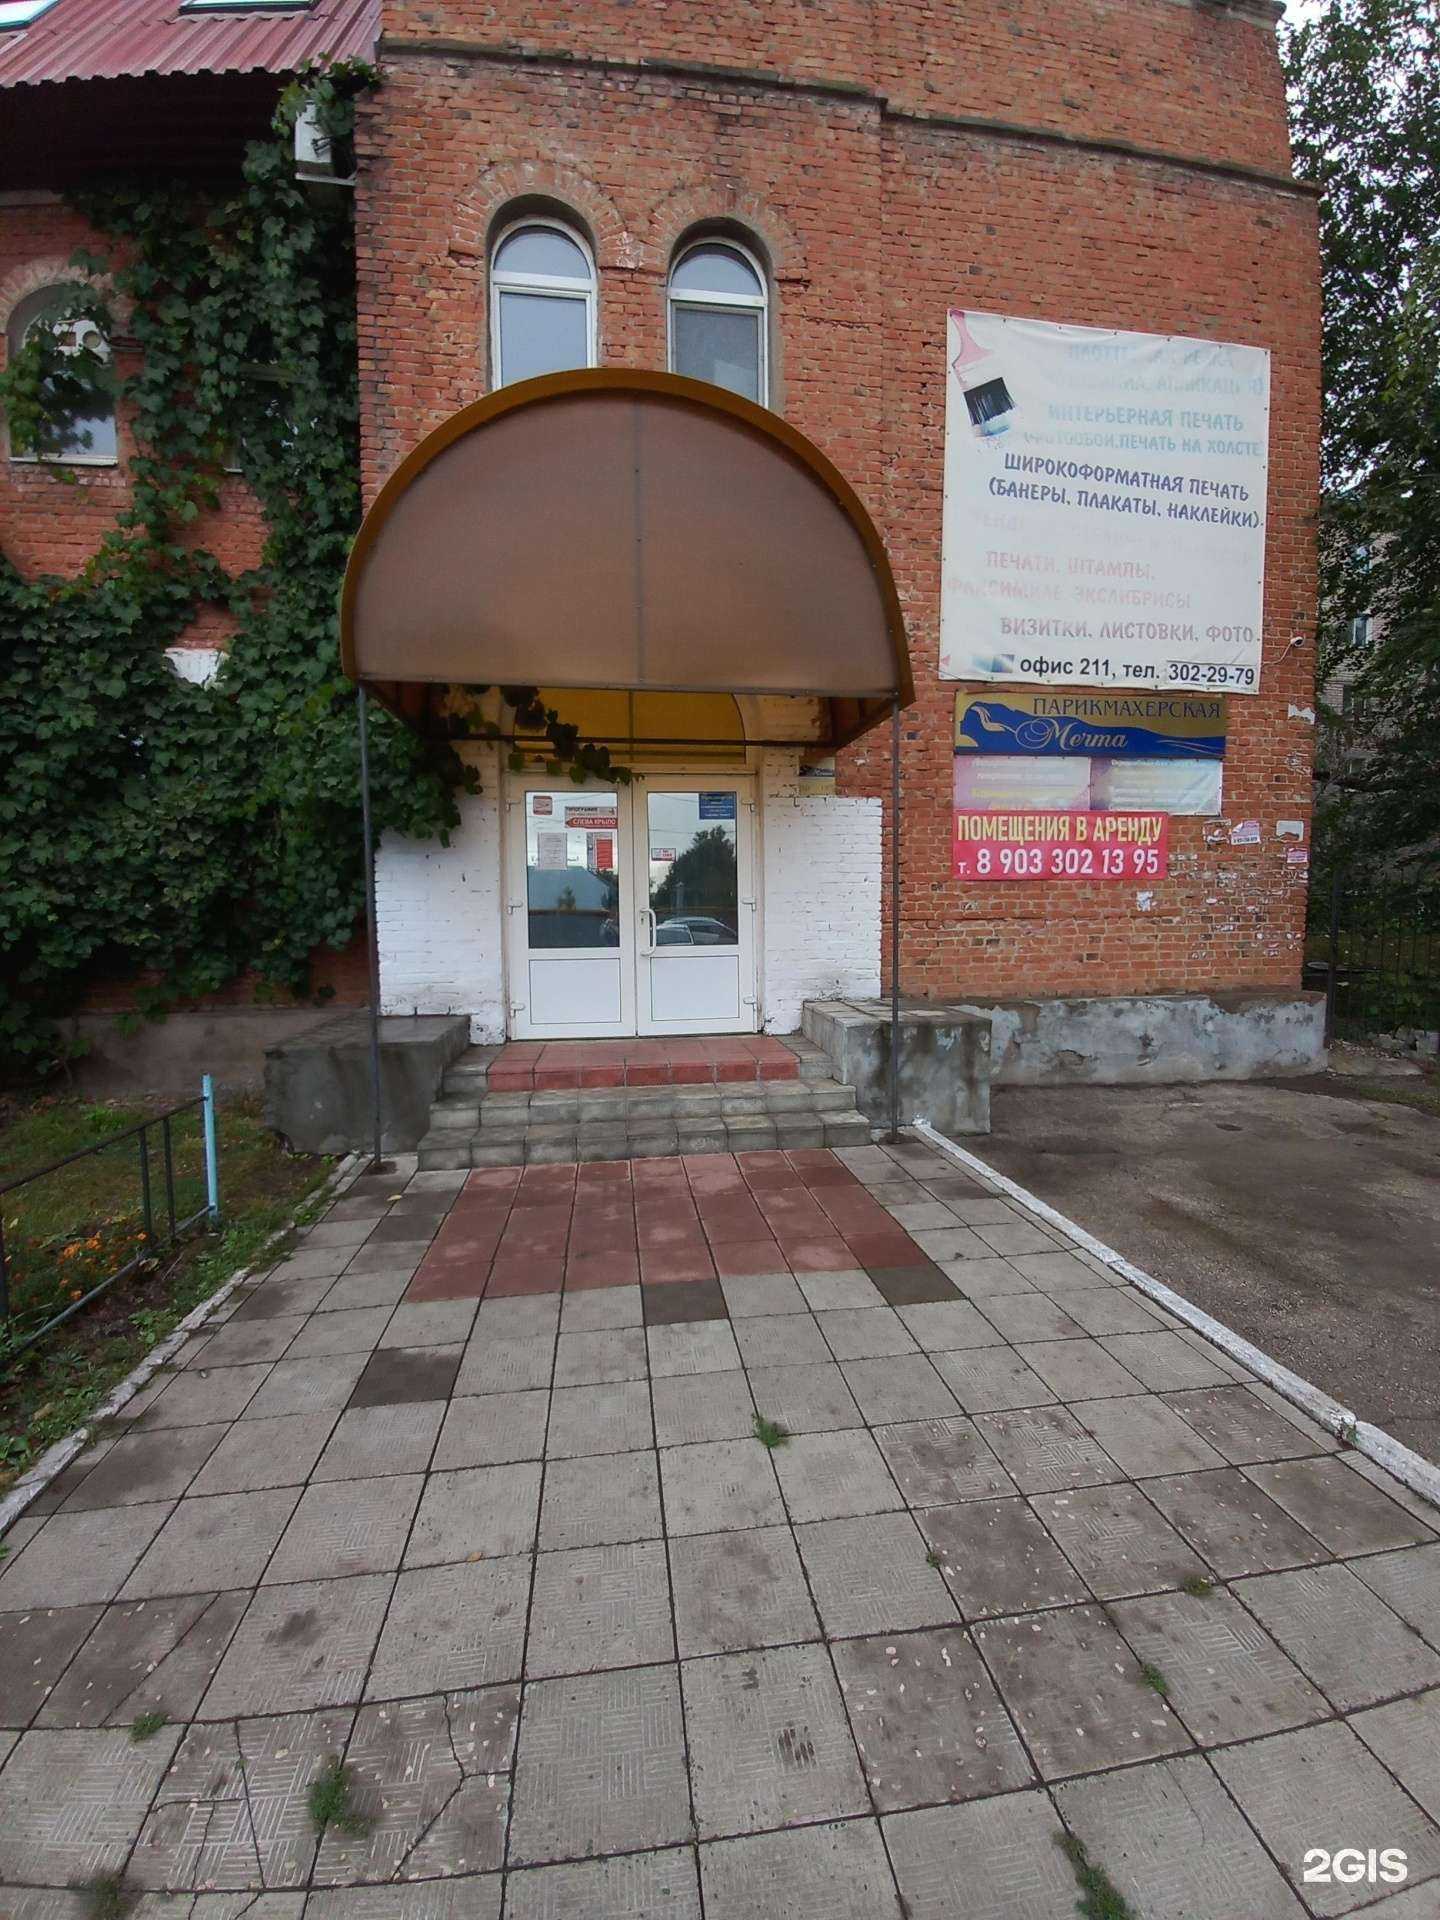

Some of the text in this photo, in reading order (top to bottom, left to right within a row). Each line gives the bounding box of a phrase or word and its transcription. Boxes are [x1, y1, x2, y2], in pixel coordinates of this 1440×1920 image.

[1180, 409, 1244, 432] ПЕЧАТЬ
[1182, 438, 1202, 454] НА
[1004, 452, 1250, 502] ШИРОКОФОРМАТНАЯ ПЕЧАТЬ
[1019, 655, 1256, 686] офис 211, тел. 302-29-79
[1033, 697, 1221, 719] ПАРИКМАХЕРСКАЯ
[1015, 715, 1129, 751] Мечта
[957, 815, 1163, 846] ПОМЕЩЕНИЯ В АРЕНДУ
[976, 848, 991, 874] 8
[1000, 848, 1043, 874] 903
[1051, 848, 1094, 874] 302
[1101, 848, 1124, 874] 13
[1132, 848, 1159, 874] 95
